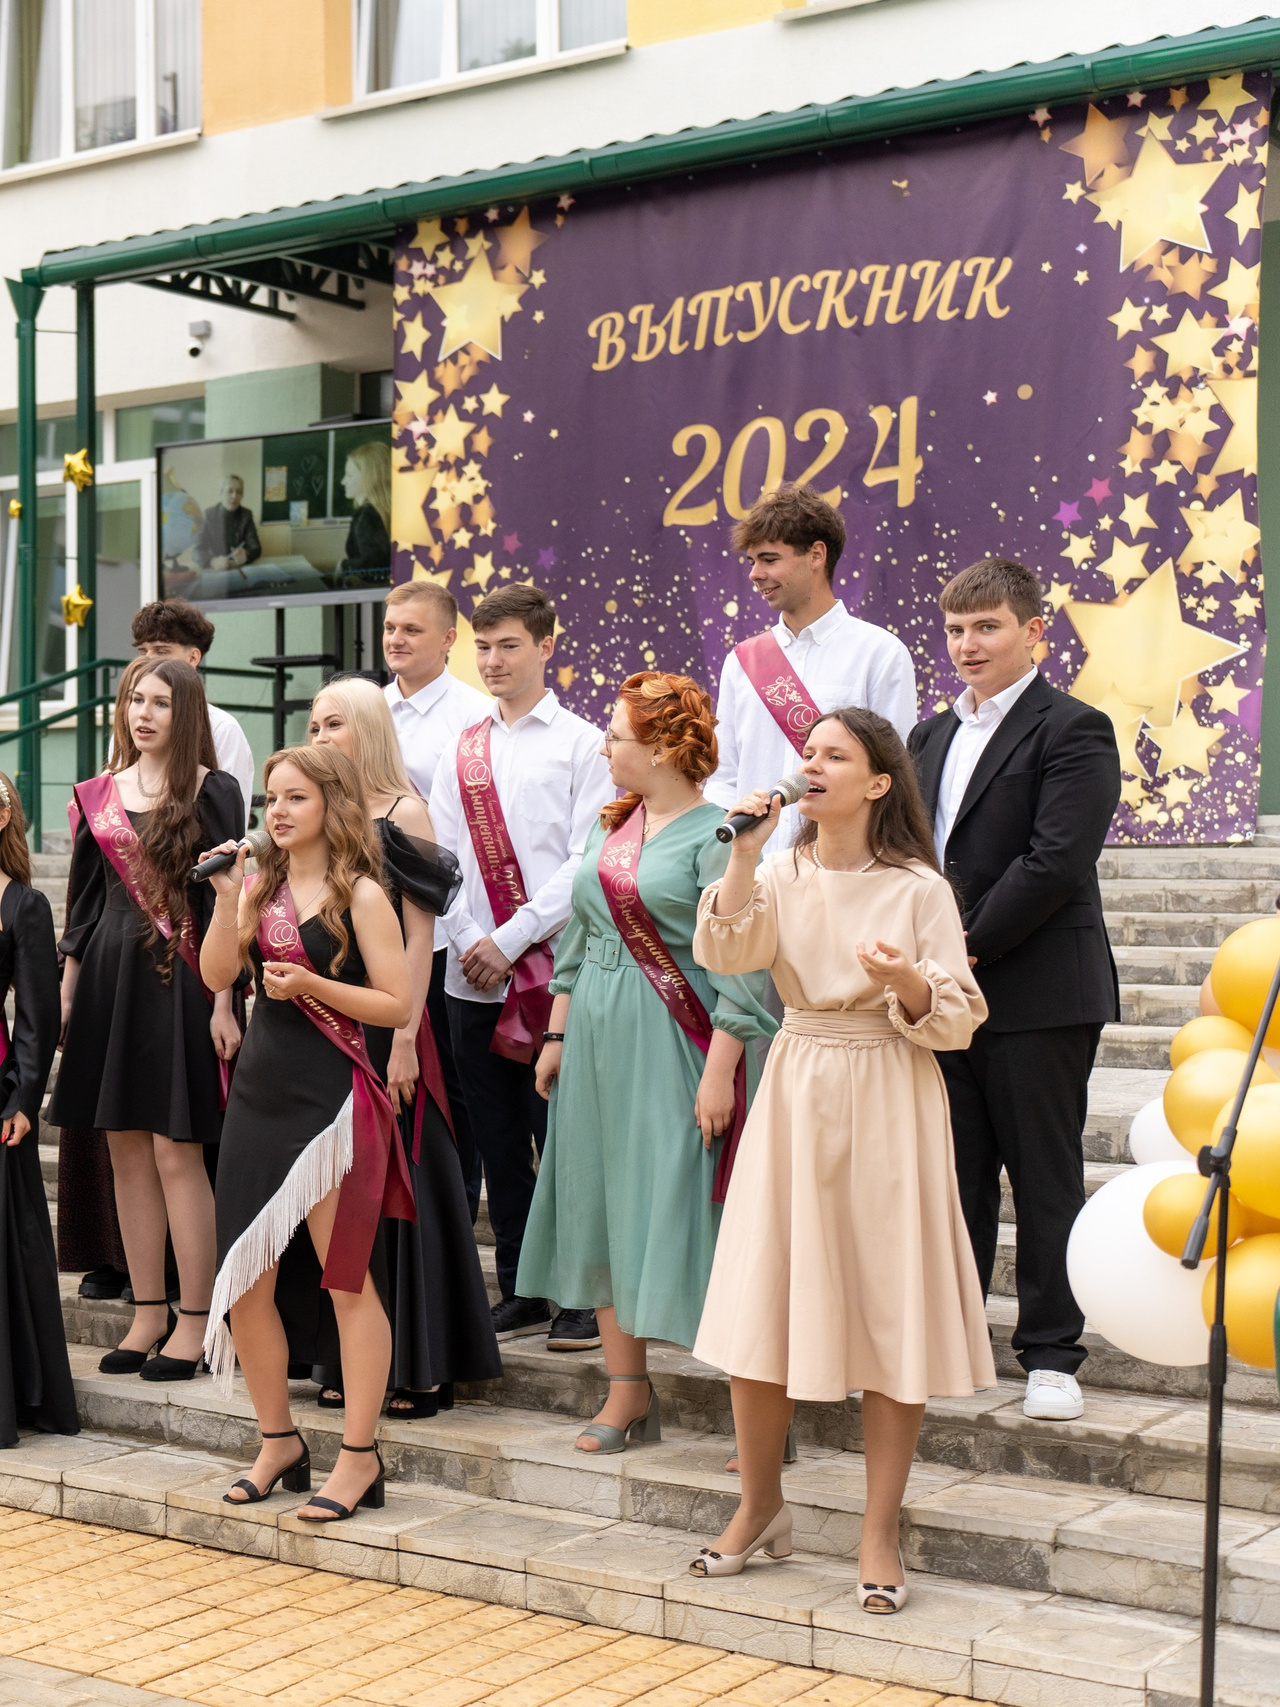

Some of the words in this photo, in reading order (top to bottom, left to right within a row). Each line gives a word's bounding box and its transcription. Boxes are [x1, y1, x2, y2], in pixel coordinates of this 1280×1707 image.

[587, 256, 1013, 371] ВЫПУСКНИК
[663, 395, 924, 527] 2024
[463, 758, 501, 874] Выпускник
[492, 870, 522, 912] 2024
[610, 871, 686, 989] Выпускница
